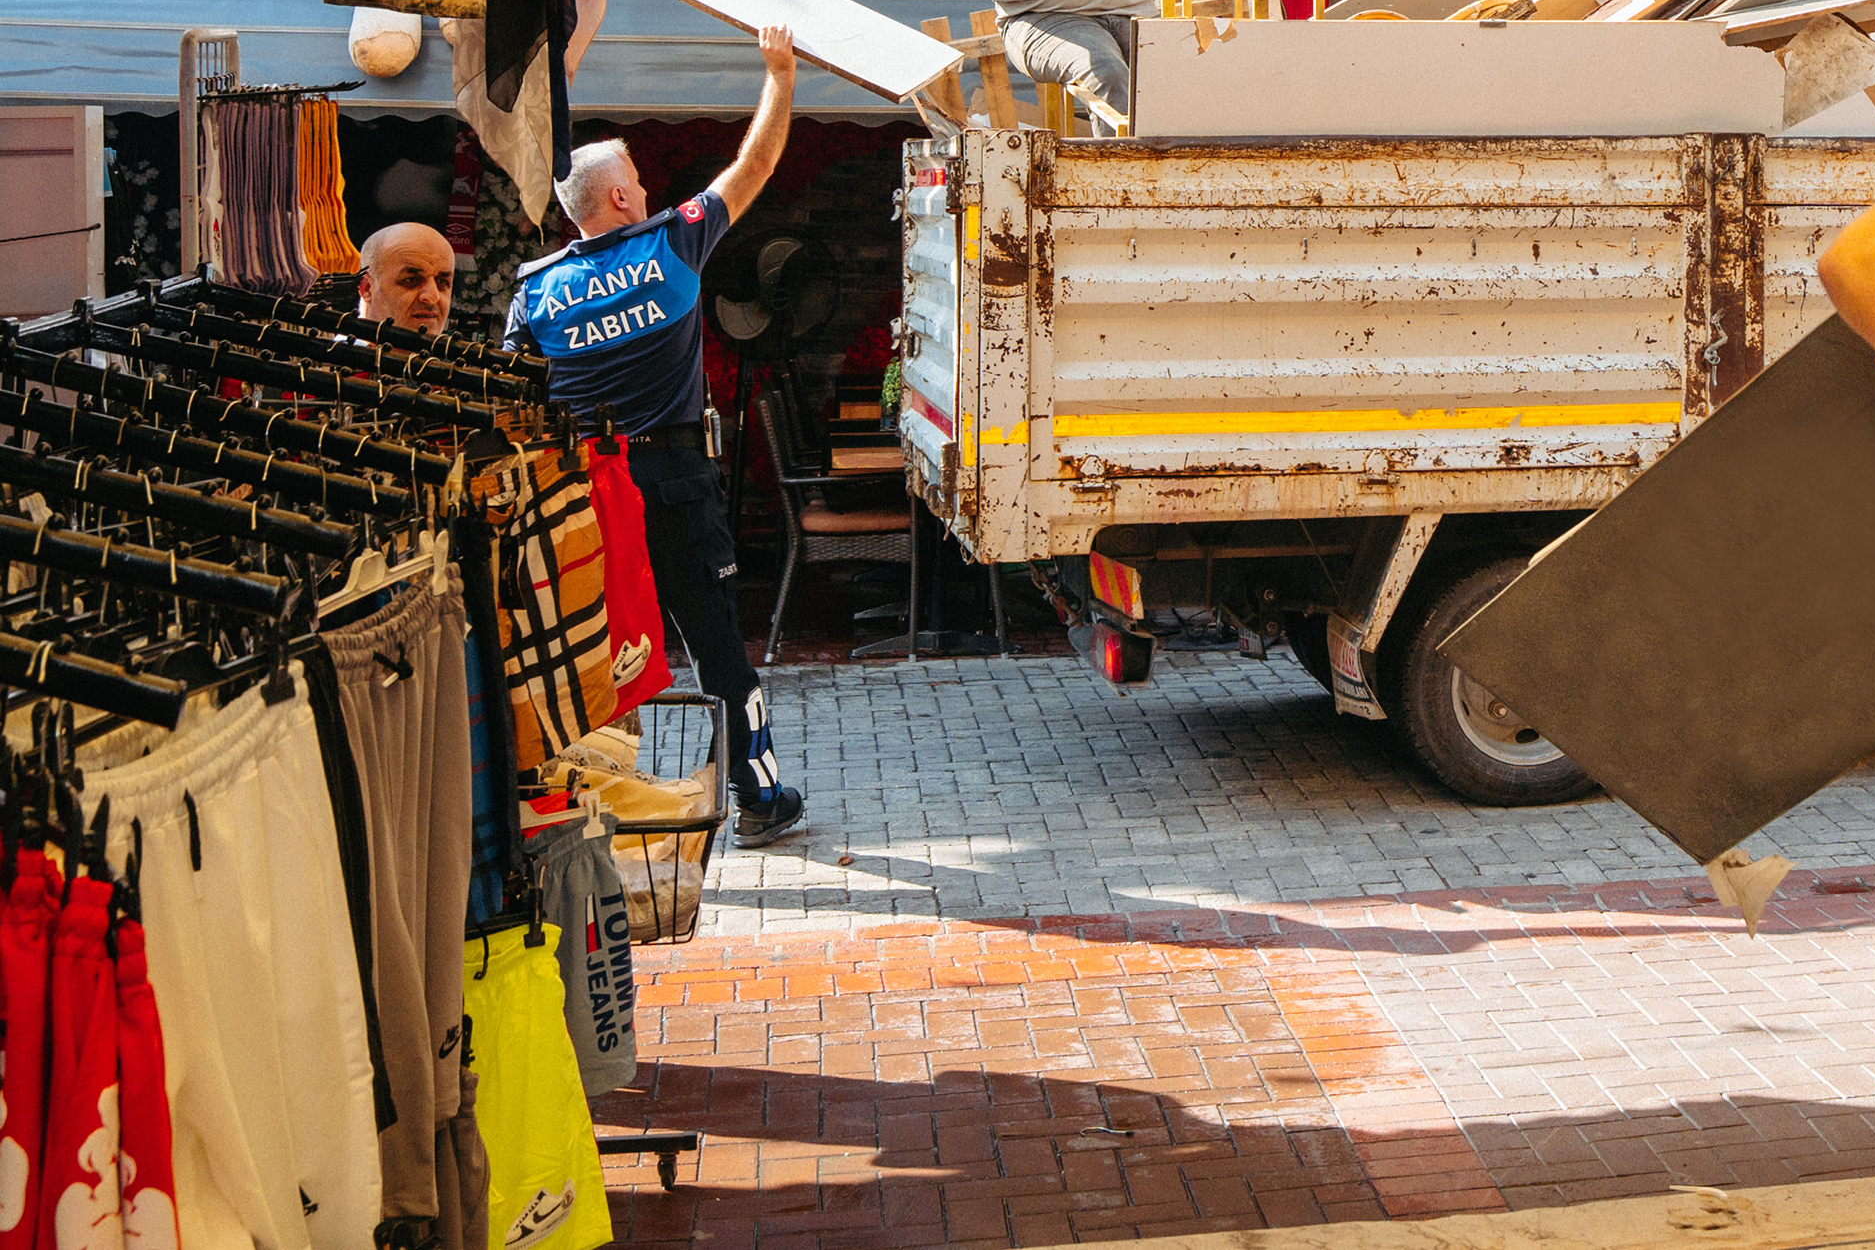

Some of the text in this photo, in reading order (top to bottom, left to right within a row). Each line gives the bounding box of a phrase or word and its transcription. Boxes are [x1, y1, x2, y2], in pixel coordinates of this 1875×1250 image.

[545, 258, 665, 321] ALANYA
[563, 299, 667, 351] ZABITA
[586, 953, 619, 1053] JEANS
